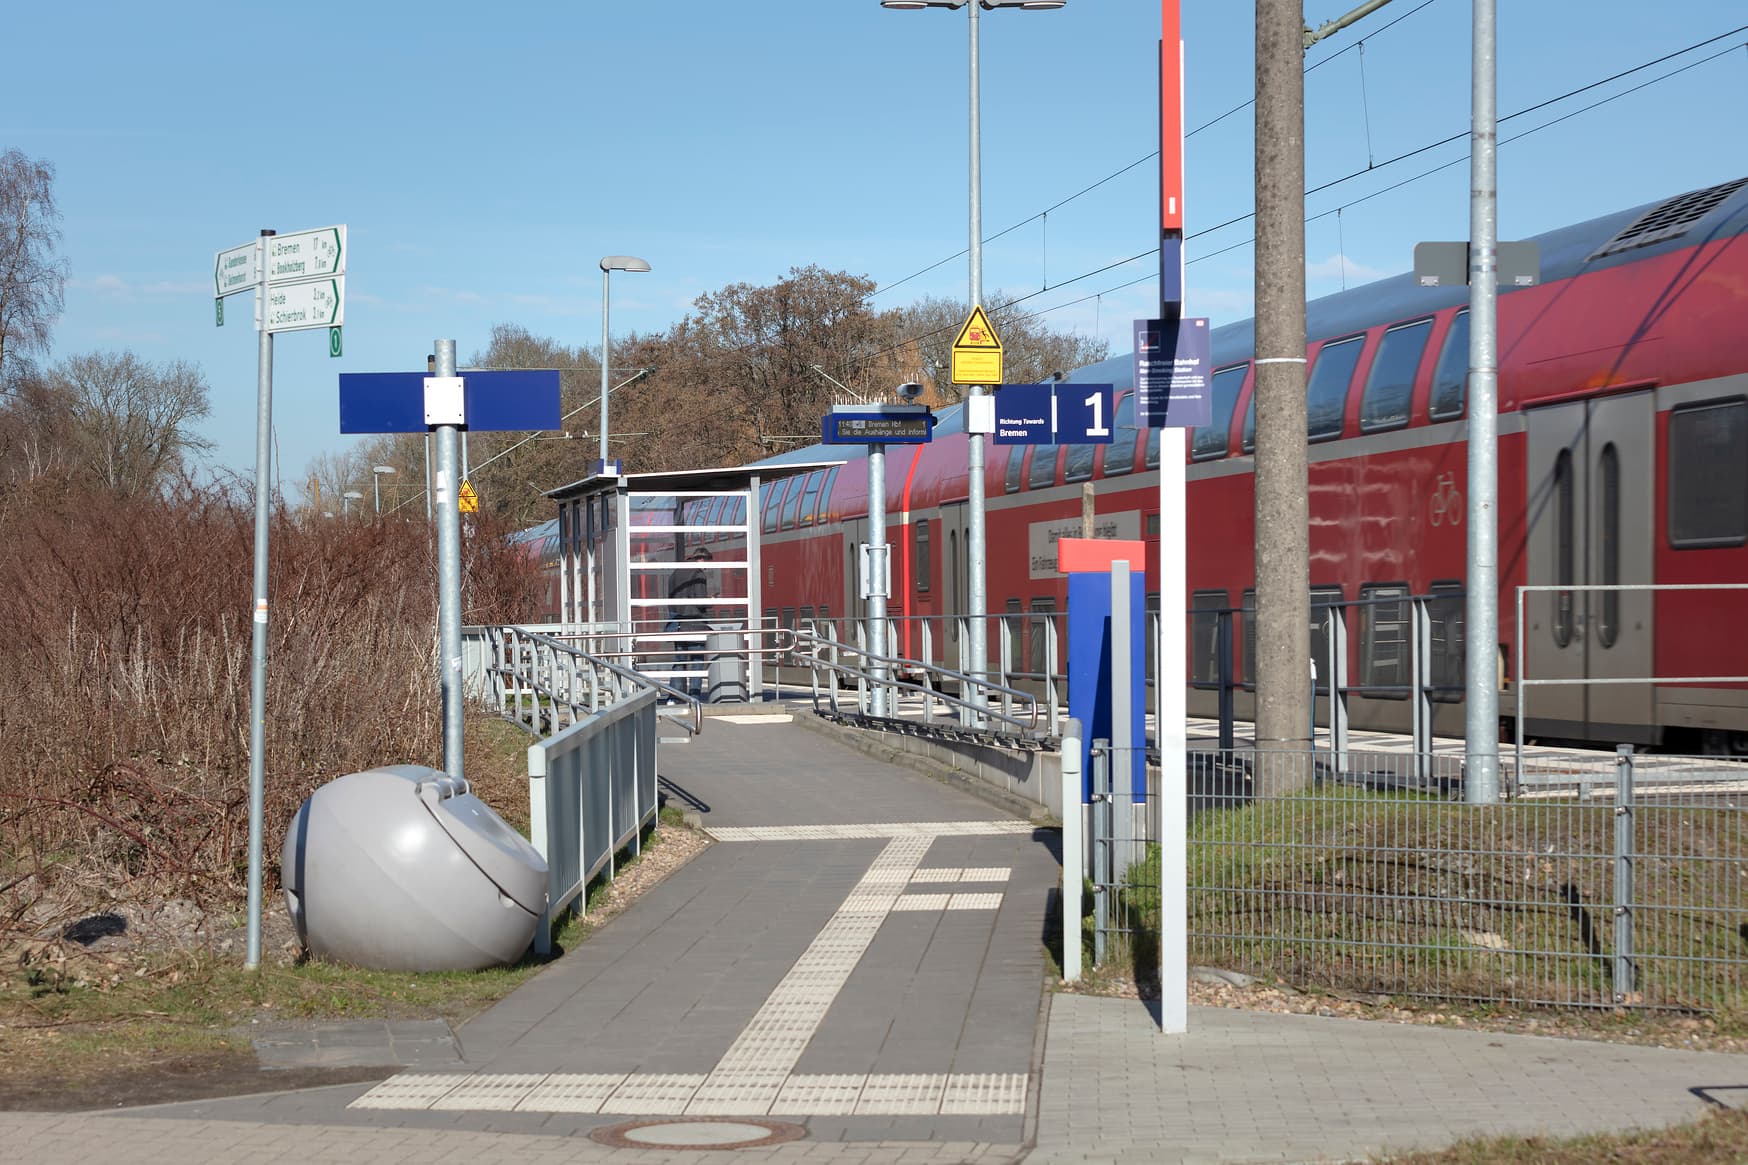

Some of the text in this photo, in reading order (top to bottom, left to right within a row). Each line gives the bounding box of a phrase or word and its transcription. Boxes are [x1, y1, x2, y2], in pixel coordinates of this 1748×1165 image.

[277, 243, 300, 256] Bremen
[1085, 391, 1109, 437] 1
[1000, 418, 1022, 426] Richtung
[999, 429, 1028, 437] Bremen
